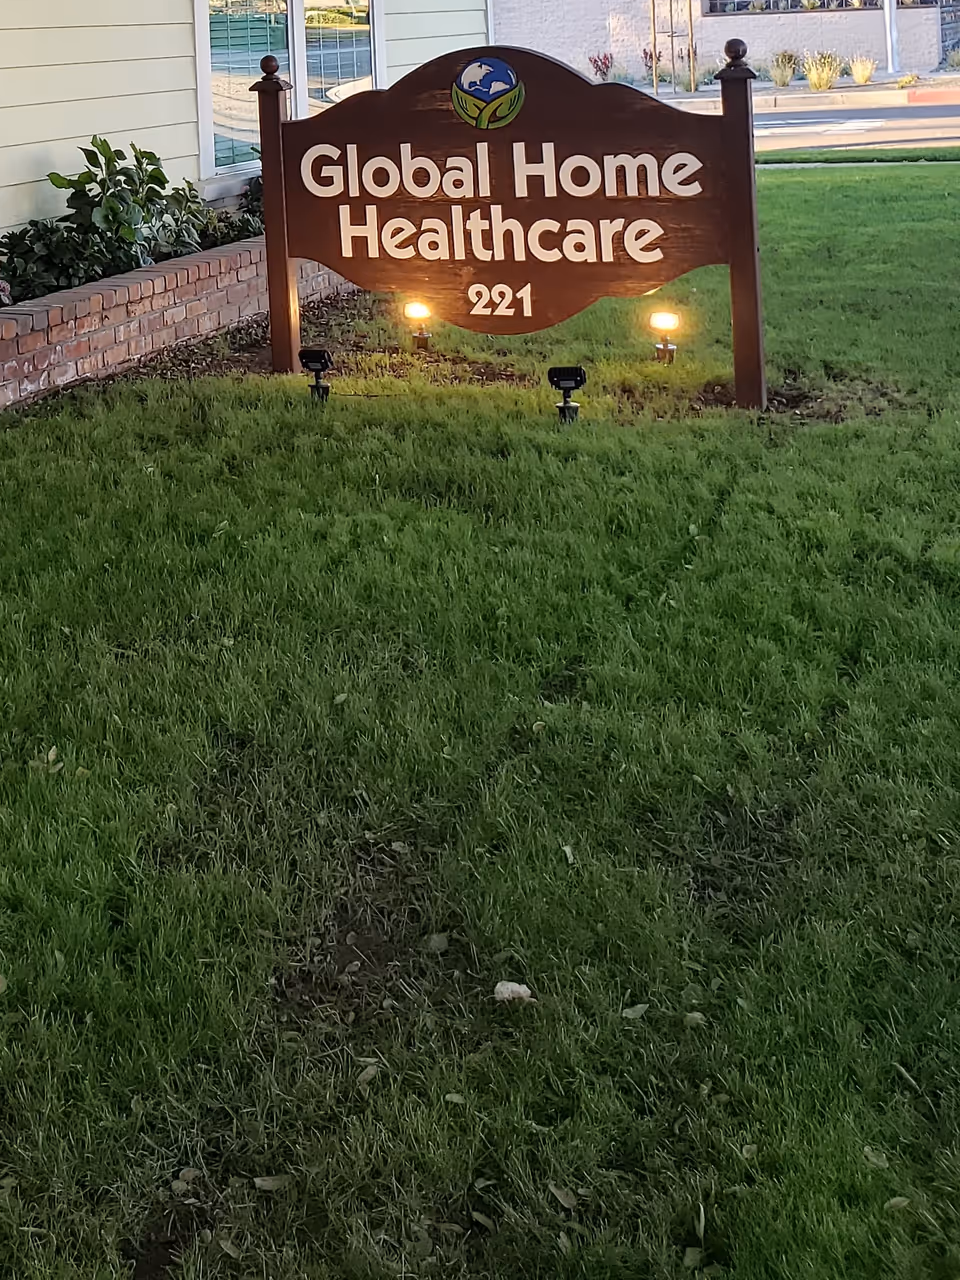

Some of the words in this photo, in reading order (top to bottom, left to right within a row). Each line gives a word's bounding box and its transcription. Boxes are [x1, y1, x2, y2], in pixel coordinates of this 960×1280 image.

[300, 141, 491, 199] Global
[512, 141, 704, 198] Home
[338, 204, 665, 264] Healthcare
[467, 282, 533, 318] 221
